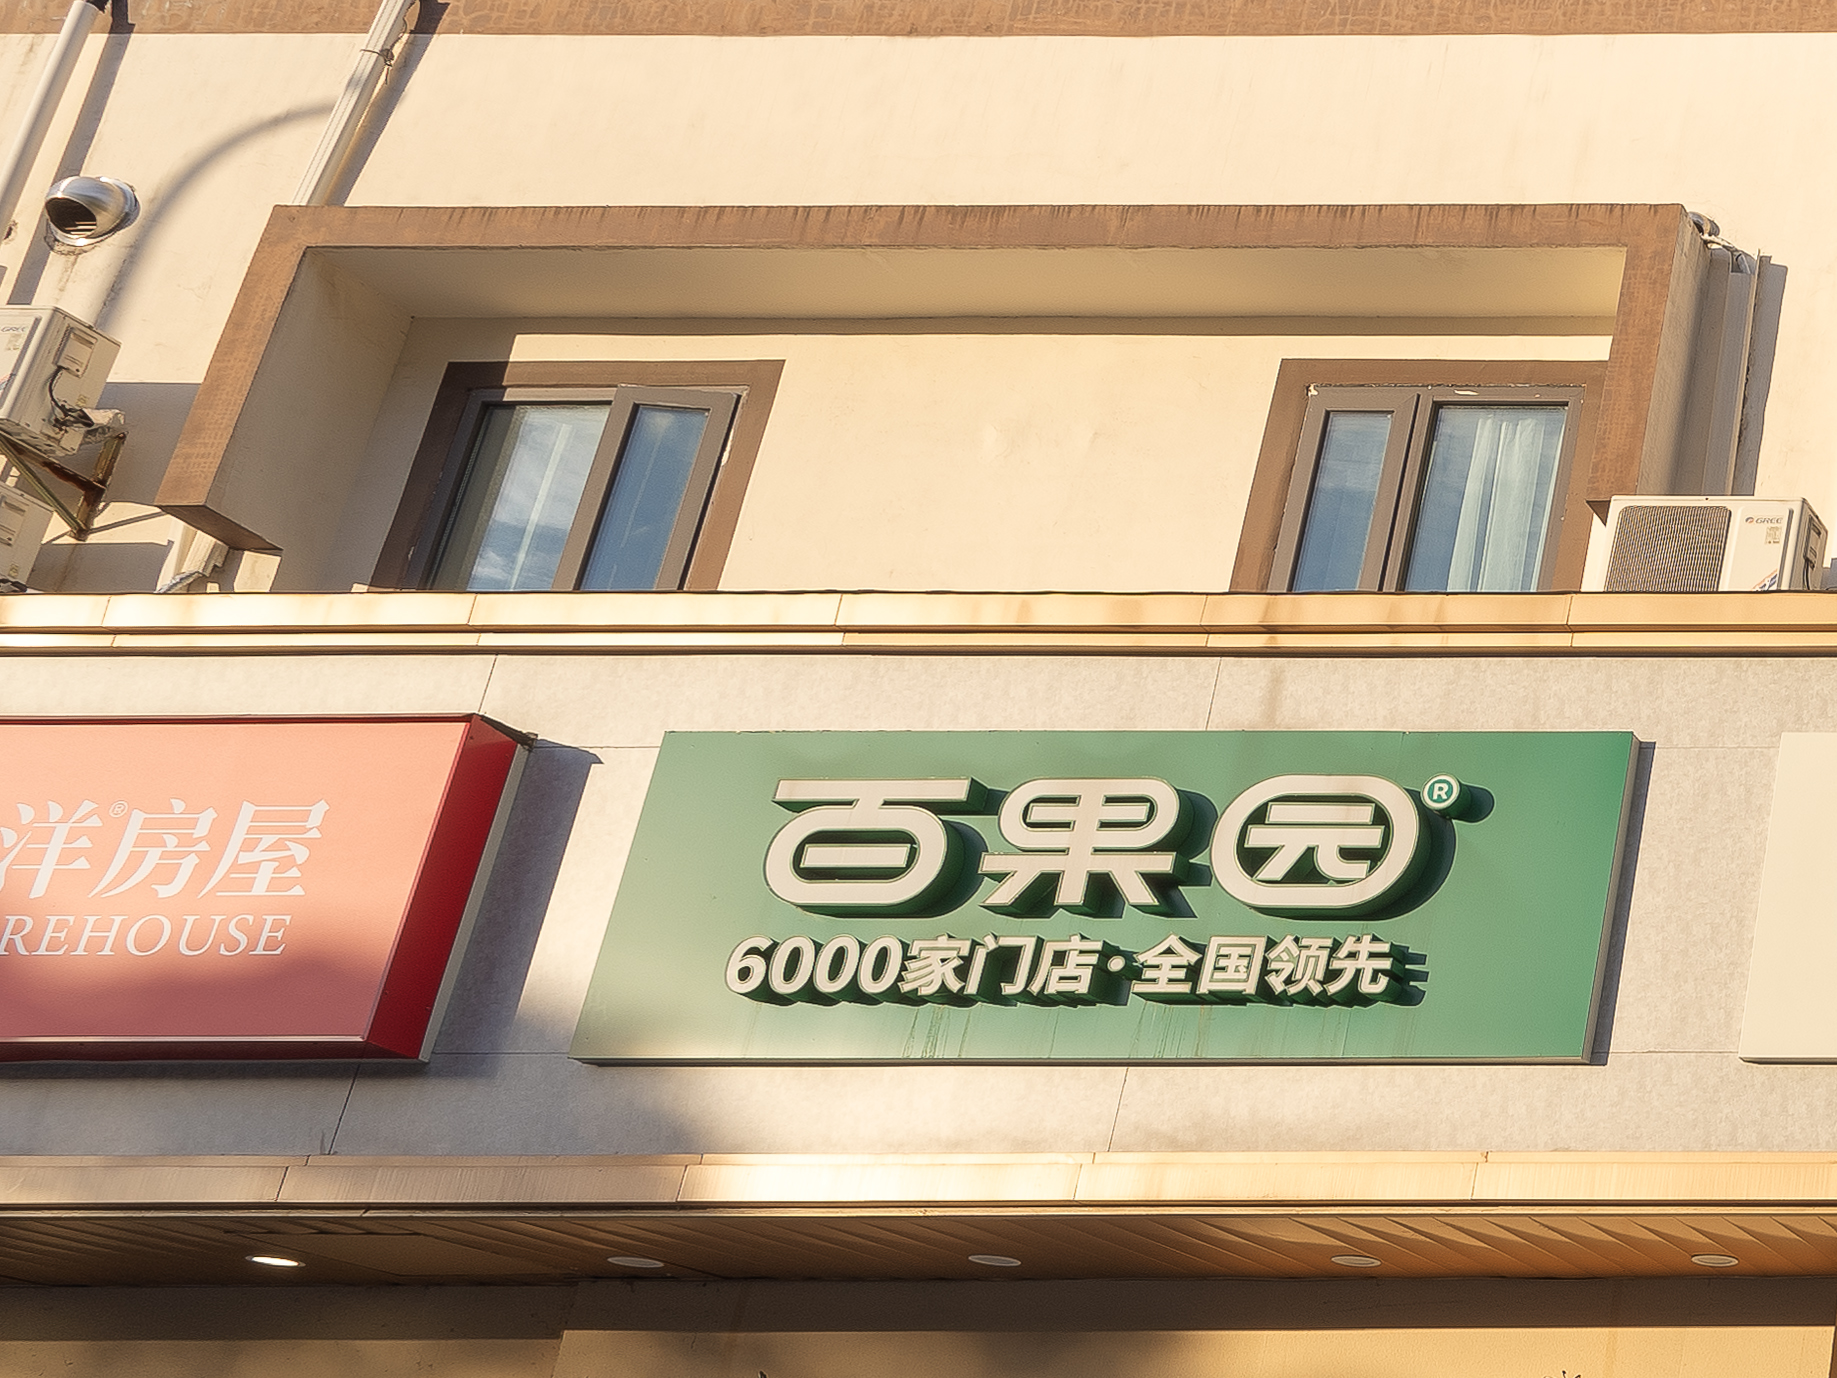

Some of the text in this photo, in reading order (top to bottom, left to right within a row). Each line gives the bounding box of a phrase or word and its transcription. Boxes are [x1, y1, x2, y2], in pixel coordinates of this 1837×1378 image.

[0, 798, 330, 901] 洋房屋
[763, 773, 1420, 909] 百果园
[0, 914, 292, 957] REHOUSE
